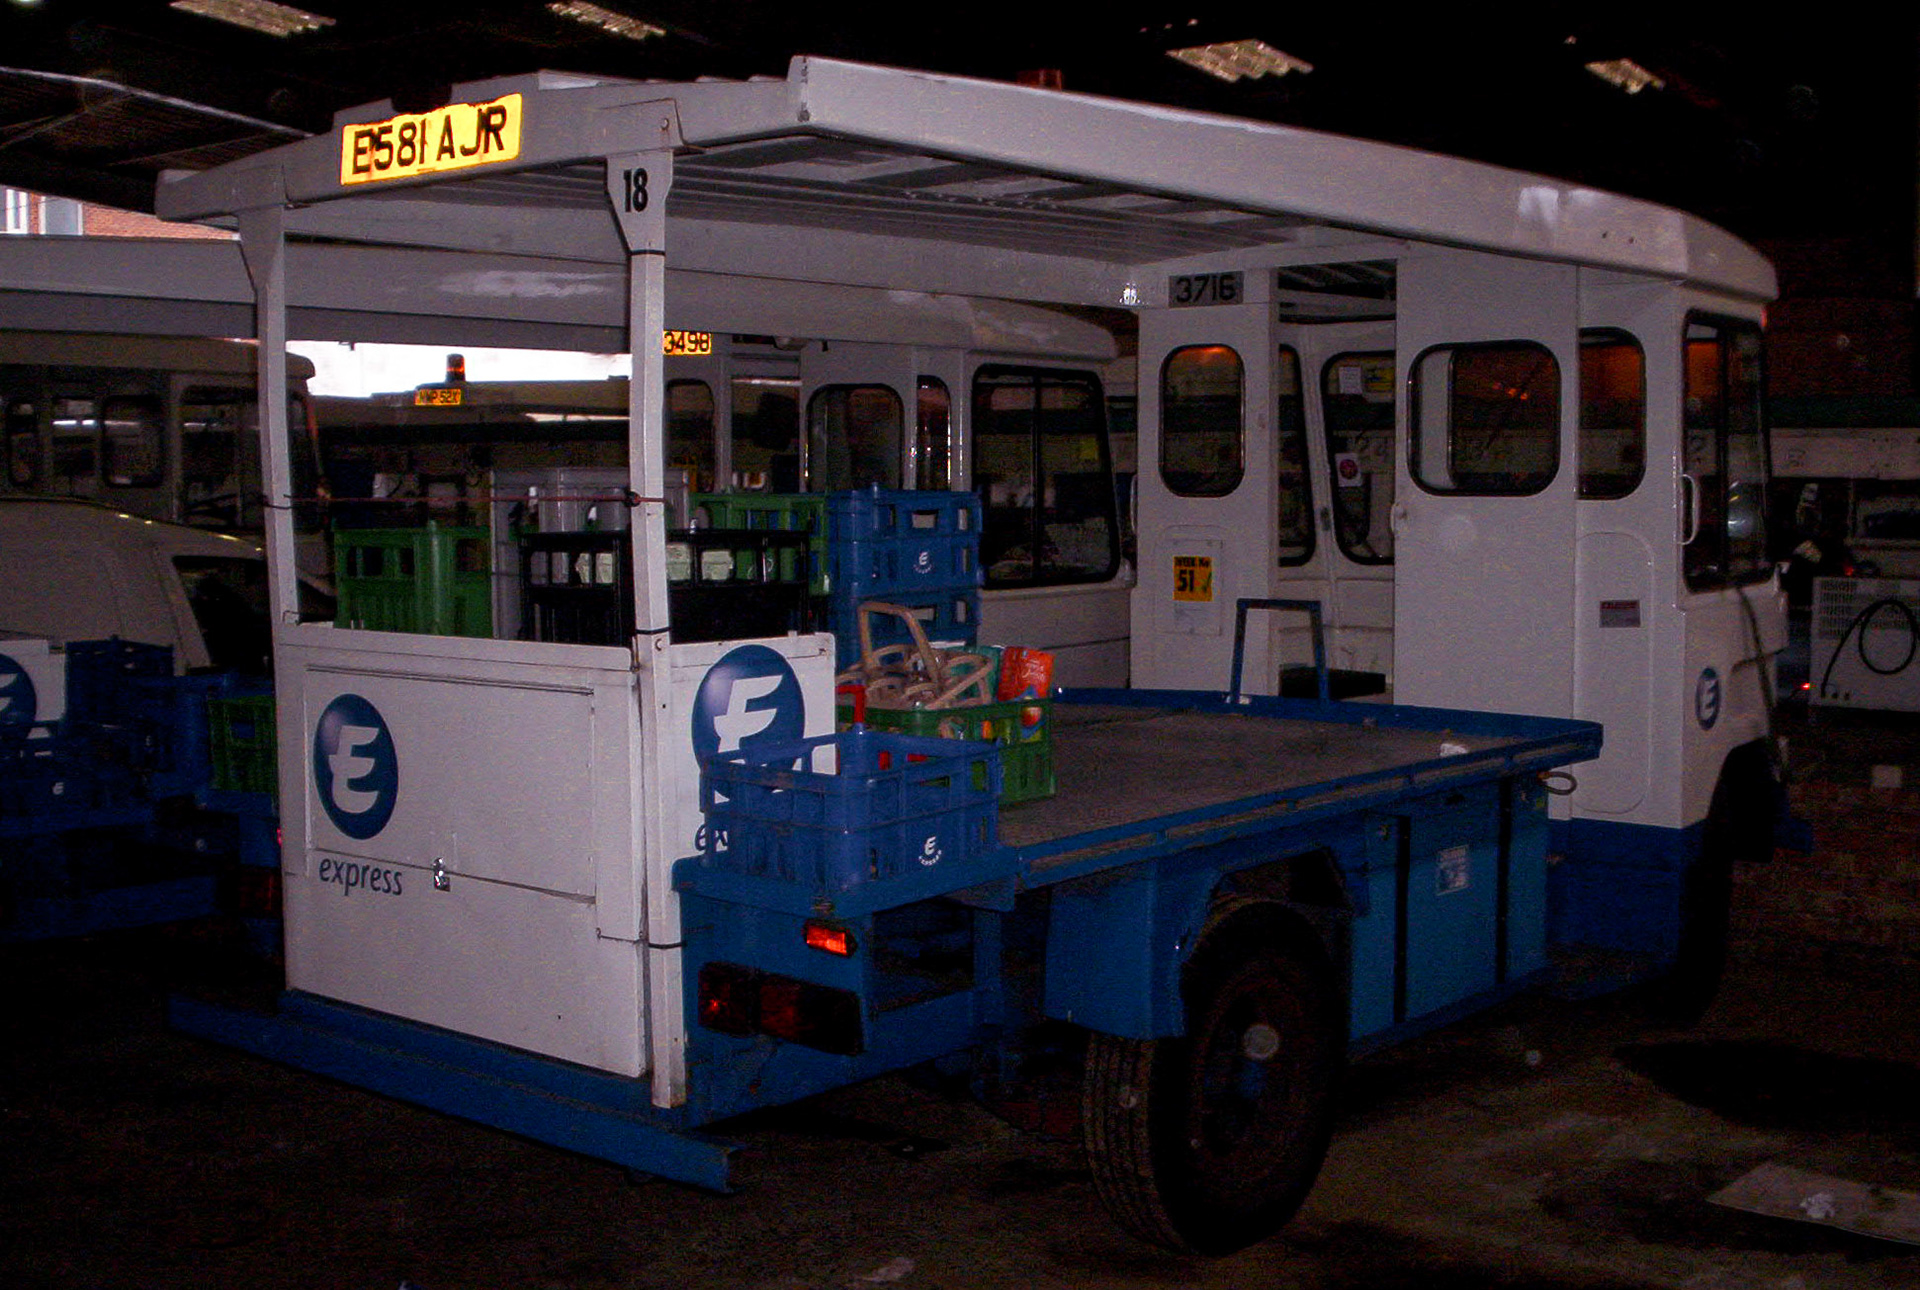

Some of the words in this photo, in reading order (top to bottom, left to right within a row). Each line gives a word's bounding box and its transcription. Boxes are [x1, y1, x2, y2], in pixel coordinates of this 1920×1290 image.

[352, 118, 427, 175] E581
[436, 104, 507, 162] AJR
[623, 168, 648, 212] 18
[1177, 274, 1236, 303] 3716
[664, 330, 710, 353] 3498
[1177, 569, 1195, 592] 51
[318, 858, 403, 897] express
